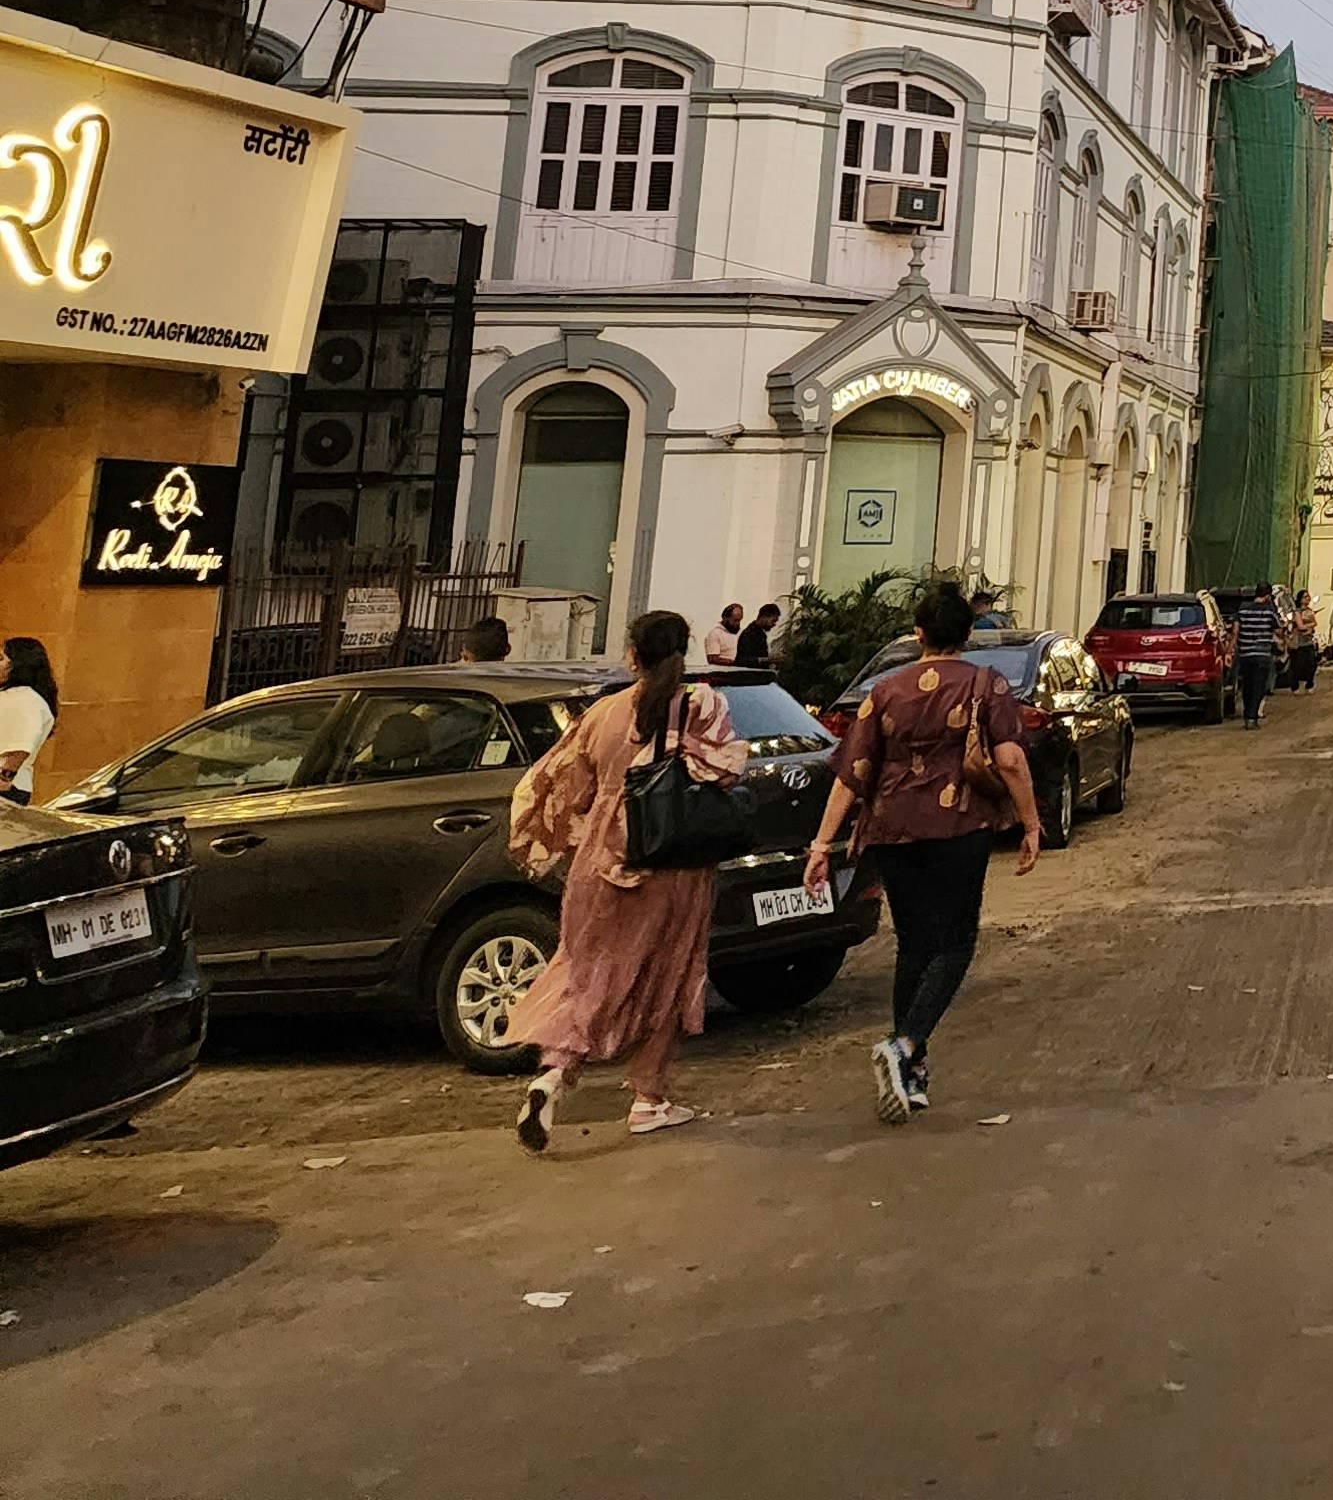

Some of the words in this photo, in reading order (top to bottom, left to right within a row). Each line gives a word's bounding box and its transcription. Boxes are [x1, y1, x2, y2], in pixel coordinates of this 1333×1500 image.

[56, 306, 89, 330] GST
[831, 374, 881, 412] JATIA
[883, 370, 977, 413] CHAMBERS
[81, 917, 96, 940] 01
[98, 912, 116, 935] DE
